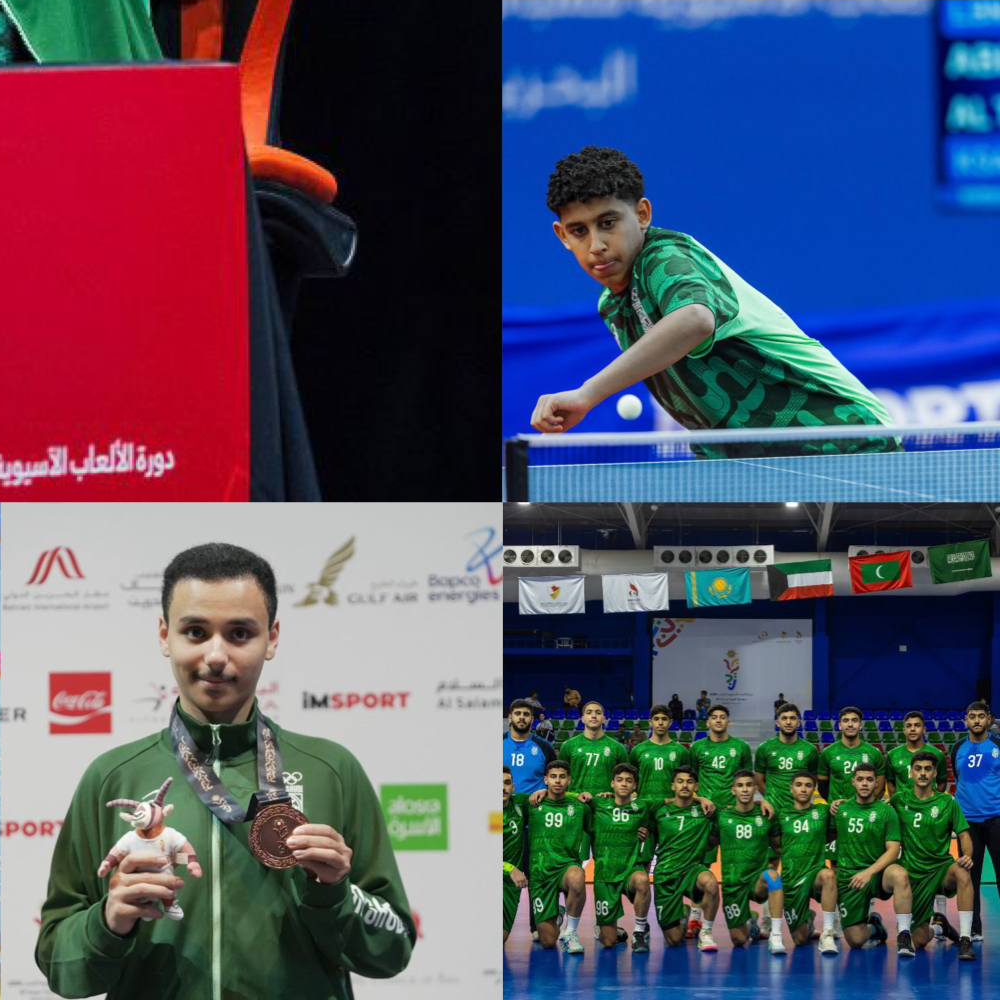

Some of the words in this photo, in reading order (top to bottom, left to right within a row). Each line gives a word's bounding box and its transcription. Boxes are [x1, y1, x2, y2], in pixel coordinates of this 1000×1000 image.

[68, 438, 134, 481] الألعاب
[135, 446, 176, 478] دورة
[428, 574, 481, 588] Bapco
[347, 593, 387, 605] GULF
[394, 592, 418, 603] AIR
[428, 590, 500, 604] energies
[302, 690, 411, 710] iMSPORT
[510, 753, 525, 767] 18
[586, 752, 600, 766] 77
[654, 757, 664, 771] 10
[712, 755, 726, 769] 42
[778, 756, 794, 770] 36
[967, 754, 984, 768] 37
[286, 784, 304, 793] SAUDI
[388, 794, 442, 815] alosra
[544, 812, 564, 828] 99
[612, 807, 630, 822] 96
[913, 812, 922, 828] 2
[676, 816, 685, 831] 7
[793, 818, 810, 834] 94
[848, 818, 864, 834] 55
[736, 824, 752, 840] 88
[596, 900, 610, 916] 96
[656, 906, 664, 921] 7
[725, 903, 741, 920] 88
[784, 908, 798, 926] 94
